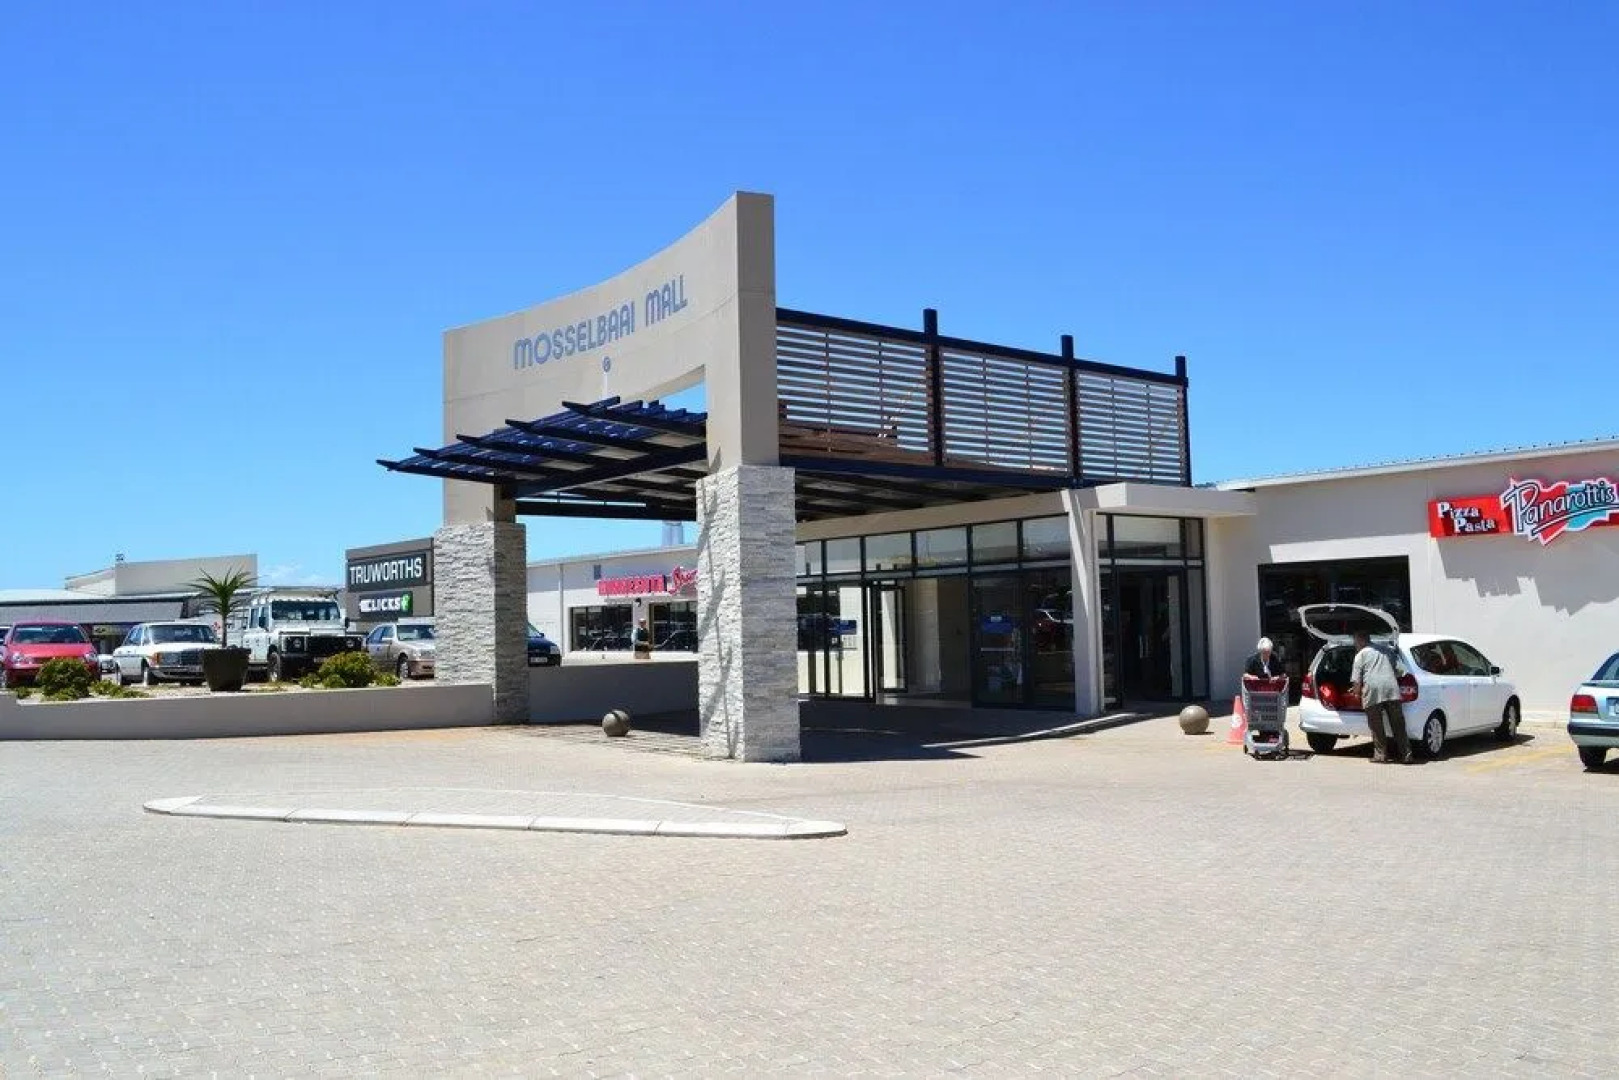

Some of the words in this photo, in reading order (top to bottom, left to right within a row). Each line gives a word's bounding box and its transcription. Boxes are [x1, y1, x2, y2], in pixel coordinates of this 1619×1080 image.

[514, 301, 636, 370] MOSSELBAAI
[645, 274, 689, 326] MALL
[1437, 501, 1479, 519] Pizza
[1504, 480, 1615, 532] Panarottis
[1454, 517, 1496, 534] Pasta
[349, 557, 422, 585] TRUWORTHS
[361, 597, 401, 613] CLICKS
